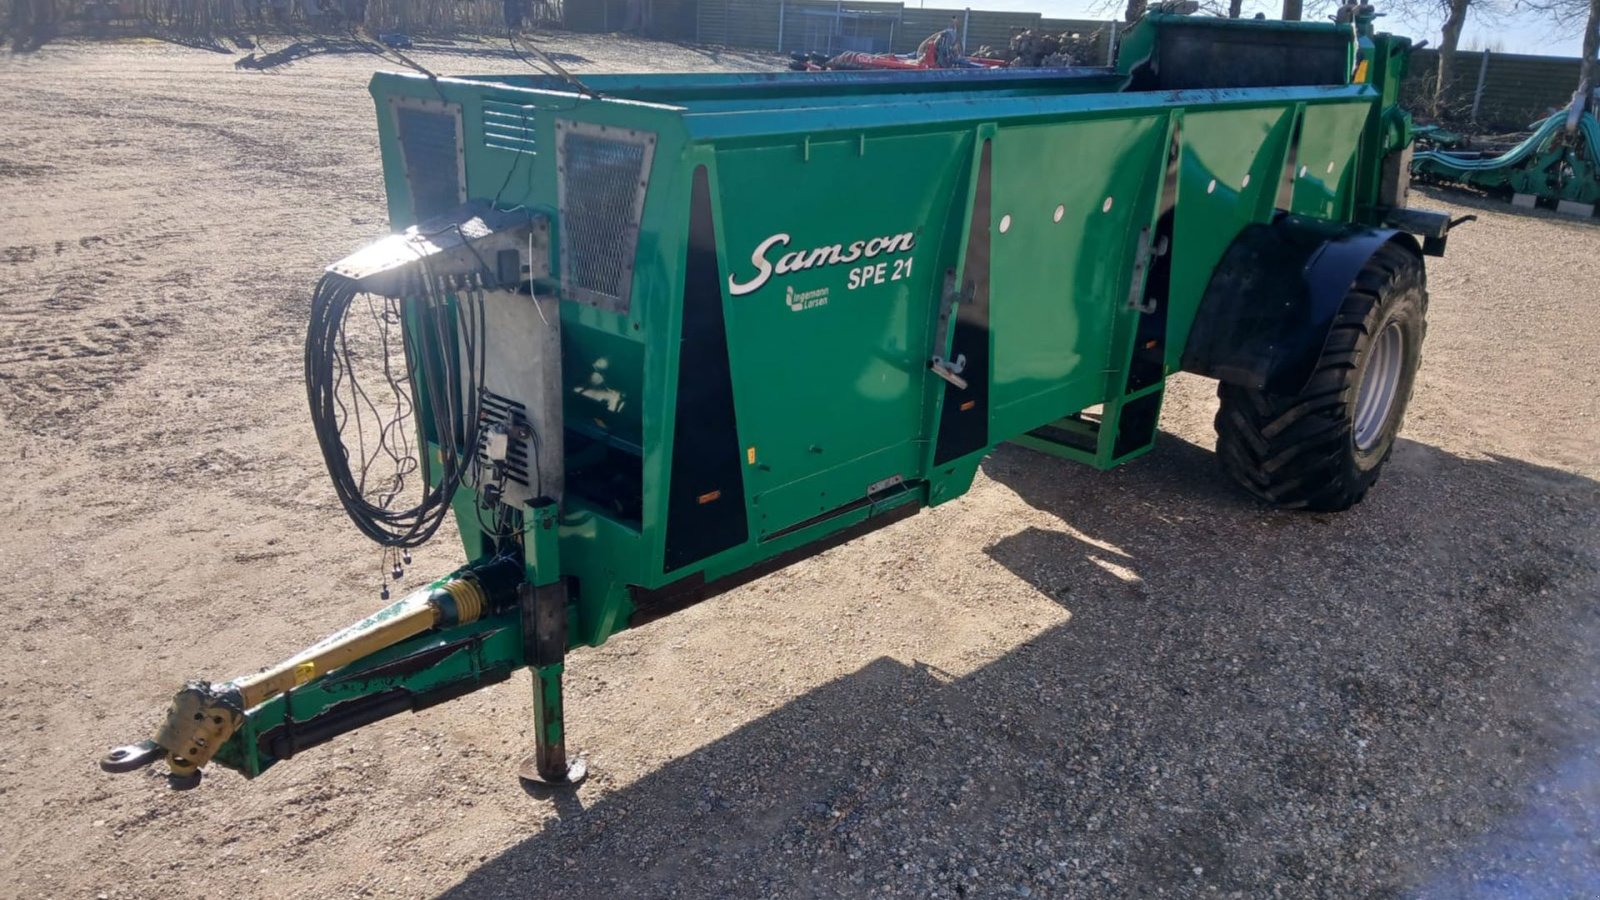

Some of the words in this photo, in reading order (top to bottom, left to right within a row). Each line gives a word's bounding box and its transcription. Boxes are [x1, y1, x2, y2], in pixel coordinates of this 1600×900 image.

[728, 232, 915, 296] Samson
[847, 262, 887, 290] SPE
[891, 257, 914, 280] 21
